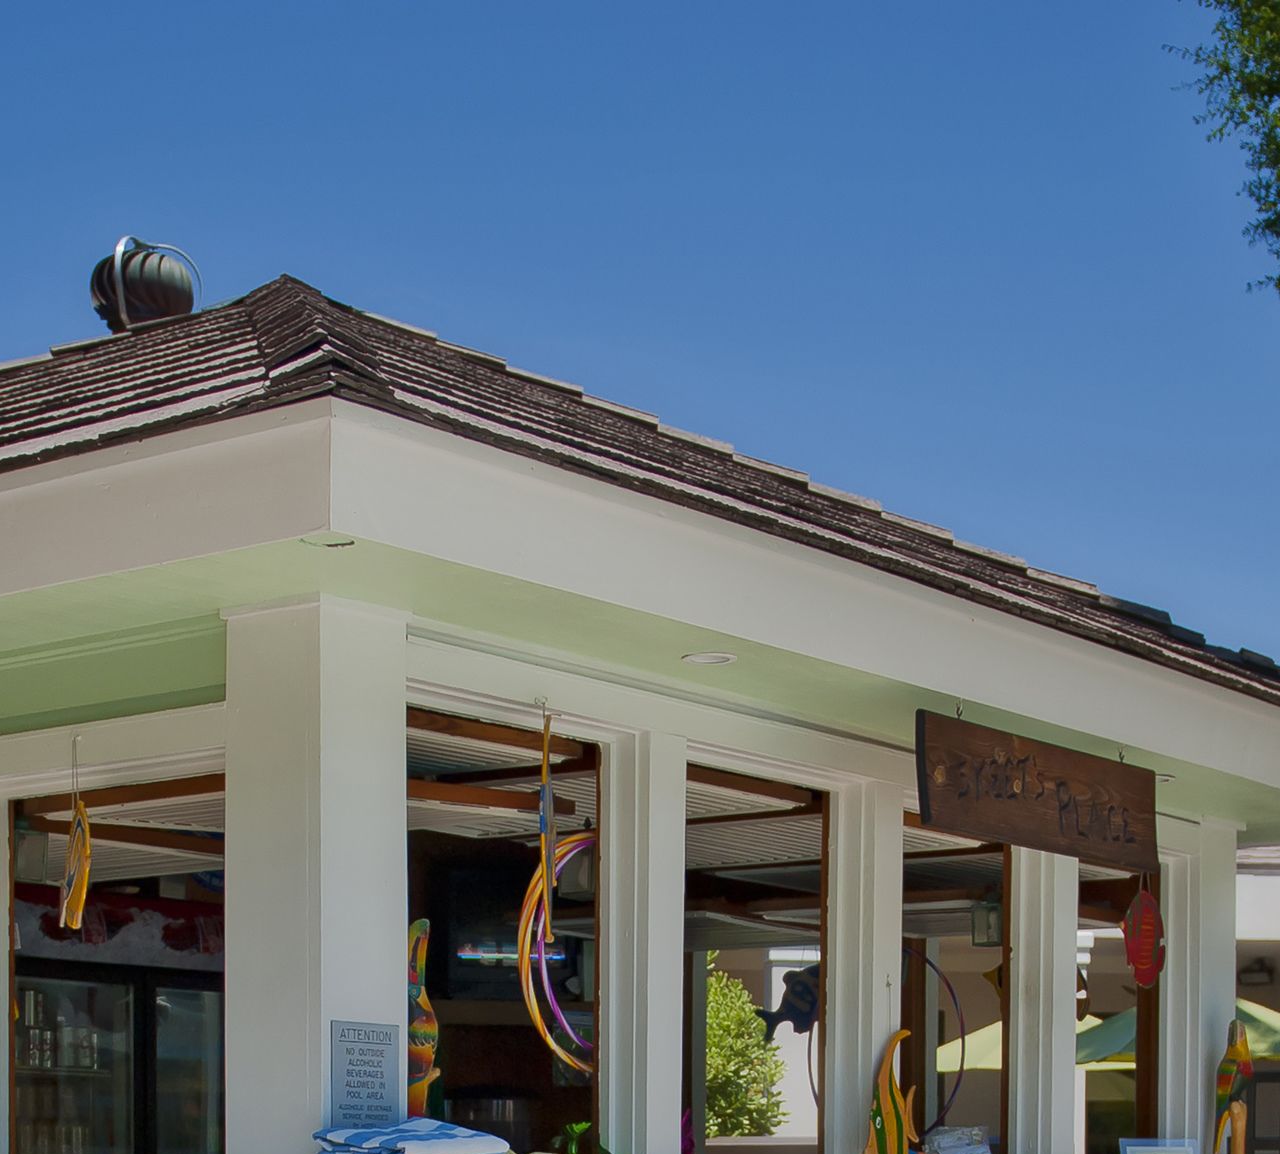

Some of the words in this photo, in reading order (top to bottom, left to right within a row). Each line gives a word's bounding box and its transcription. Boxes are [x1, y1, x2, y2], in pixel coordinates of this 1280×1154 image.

[1055, 778, 1136, 843] PLACE
[339, 1028, 392, 1043] ATTENTION
[345, 1047, 355, 1056] NO
[348, 1059, 382, 1068] ALCOHOLIC
[346, 1069, 384, 1079] BEVERAGES
[345, 1080, 375, 1089] ALLOWED
[378, 1082, 386, 1090] IN
[346, 1090, 363, 1100] POOL
[366, 1091, 385, 1101] AREA
